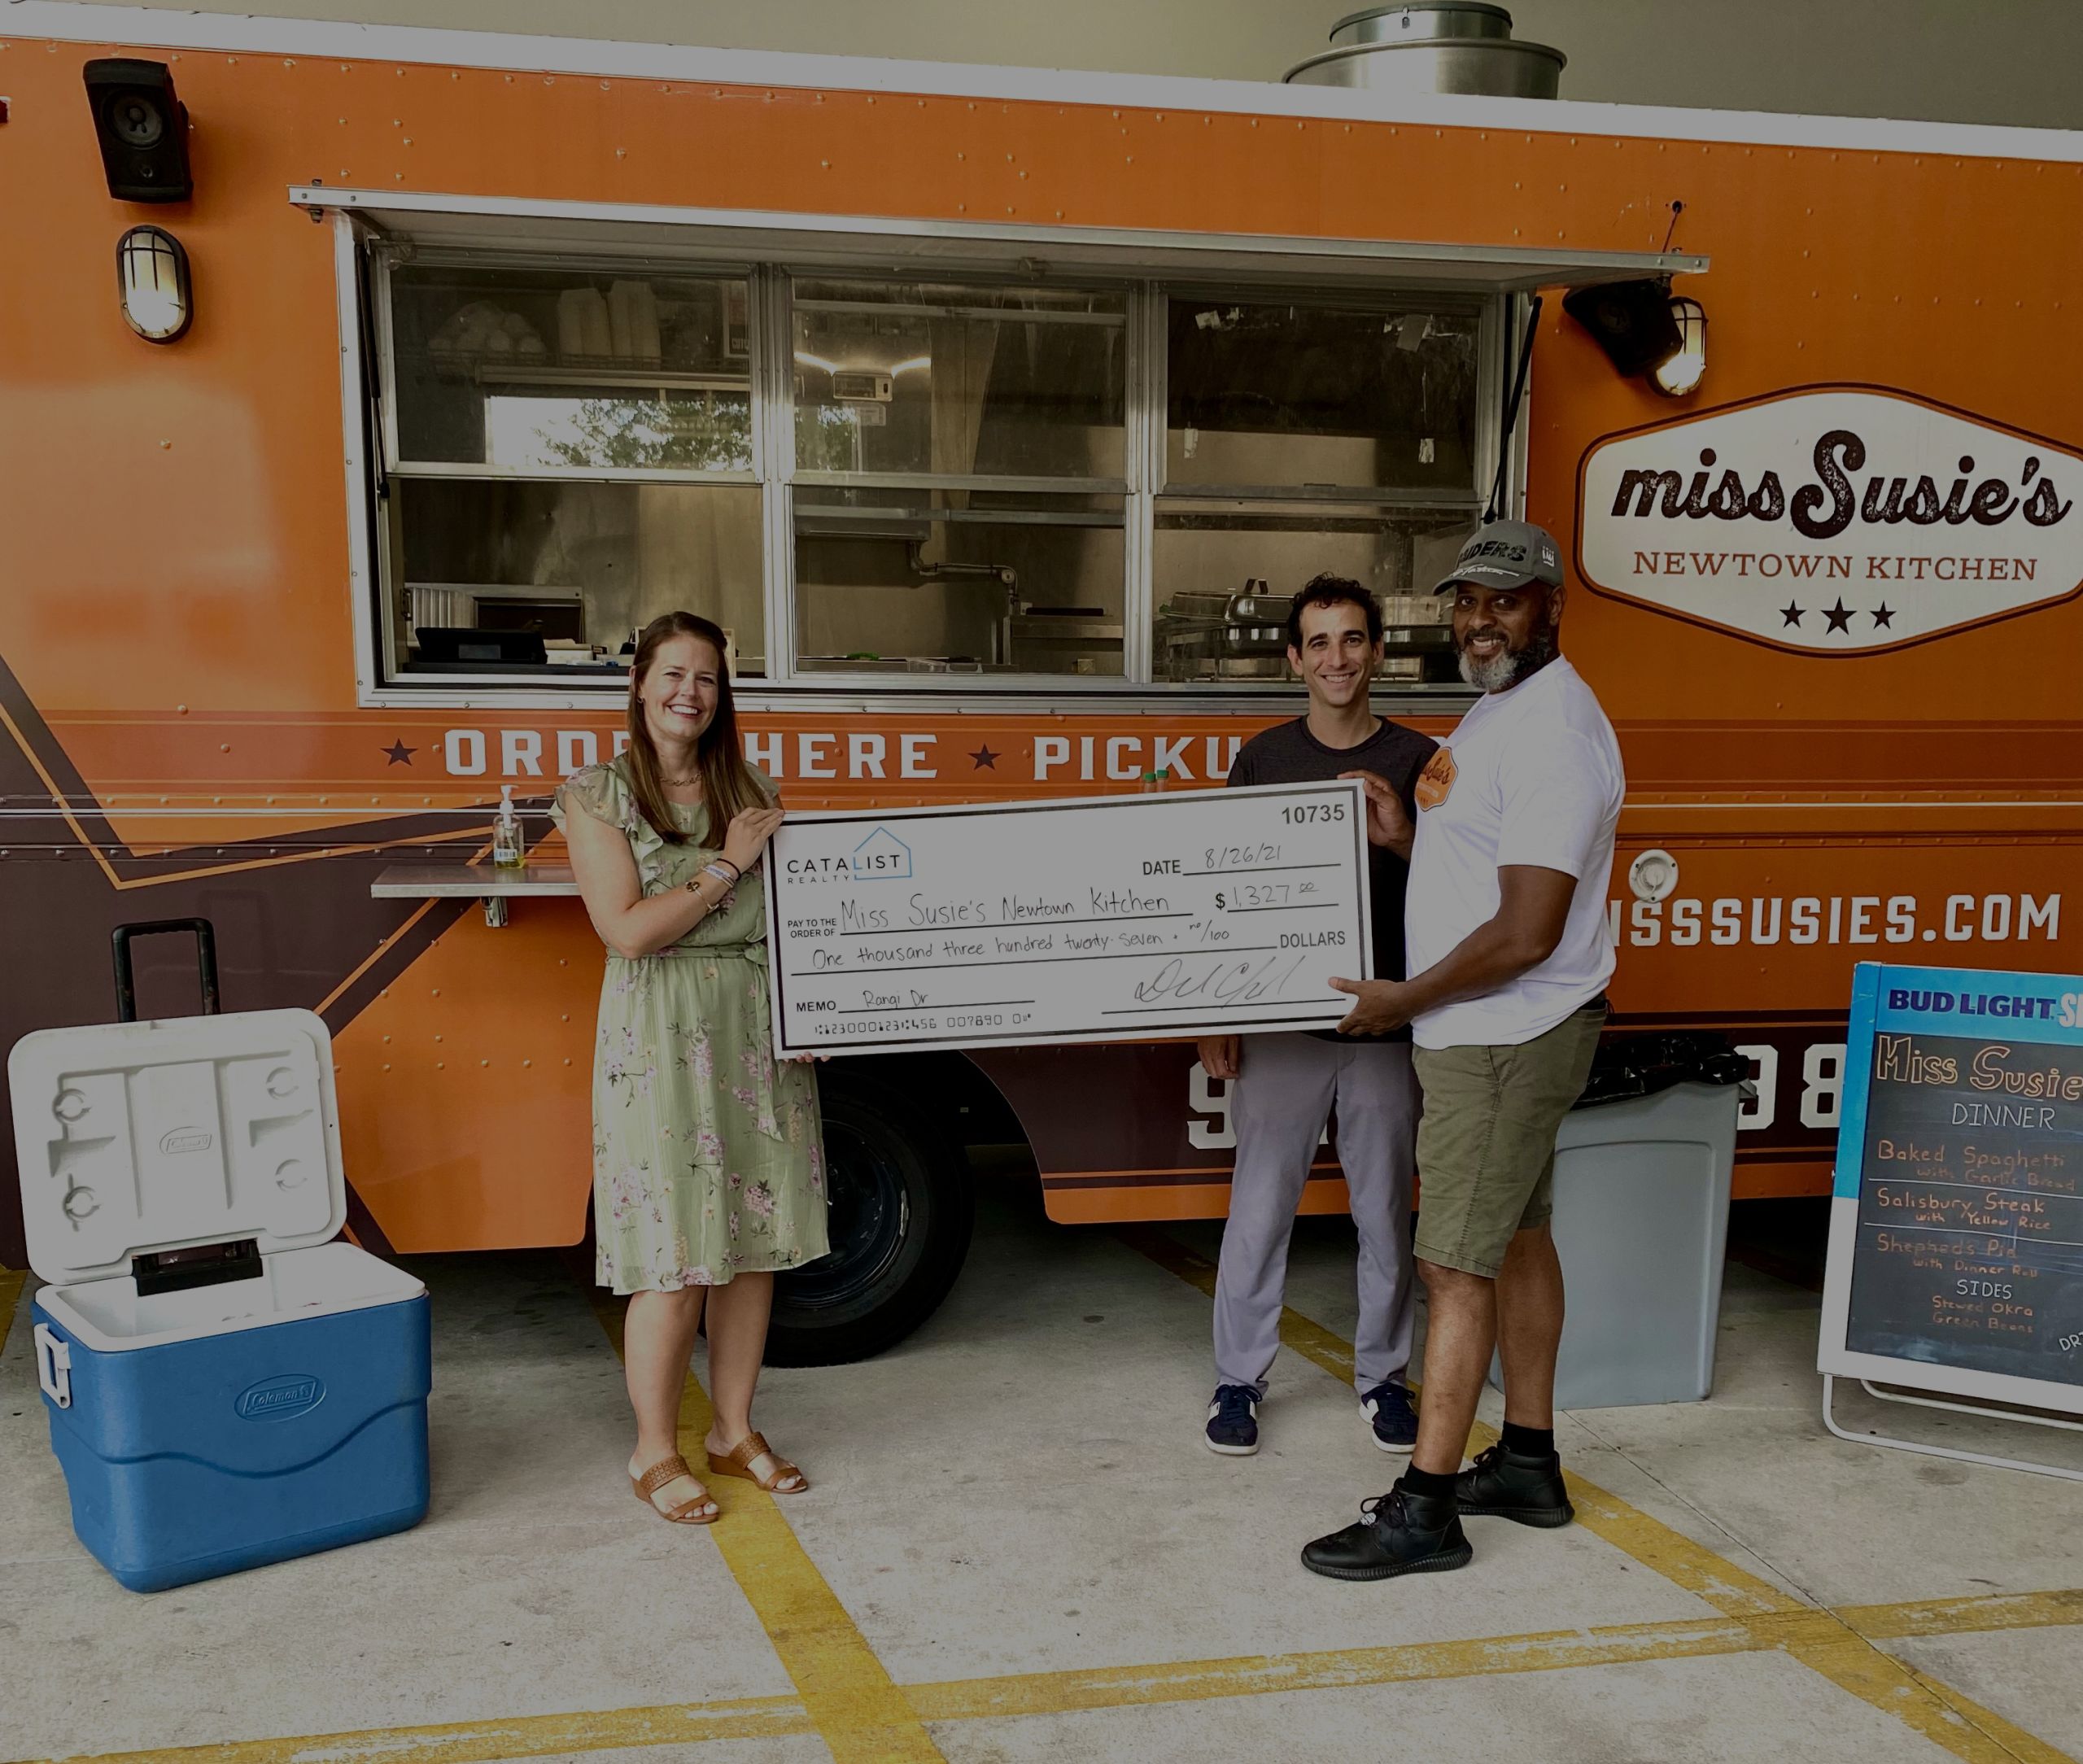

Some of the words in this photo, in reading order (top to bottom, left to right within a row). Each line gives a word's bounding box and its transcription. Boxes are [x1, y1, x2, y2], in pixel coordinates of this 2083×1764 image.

[1611, 448, 1785, 520] miss
[1789, 430, 2073, 539] Susie's
[1634, 551, 1853, 579] NEWTOWN
[1866, 557, 2038, 581] KITCHEN
[745, 732, 938, 779] HERE
[1033, 736, 1242, 781] PICKU
[1282, 804, 1345, 824] 10735
[787, 854, 900, 874] CATALIST
[1205, 843, 1282, 869] 8/26/21
[1142, 859, 1181, 875] DATE
[788, 875, 849, 884] REALTY
[841, 898, 889, 932] Miss
[908, 893, 987, 927] Susie's
[1002, 894, 1075, 921] Newtown
[1090, 886, 1169, 915] Kitchen
[788, 919, 806, 928] PAY
[806, 919, 818, 928] TO
[820, 918, 837, 927] THE
[1609, 893, 2062, 947] ISSSUSIES.COM
[790, 929, 822, 938] ORDER
[824, 928, 836, 937] OF
[1280, 931, 1346, 949] DOLLARS
[813, 949, 845, 970] One
[856, 943, 933, 963] thousand
[941, 941, 985, 958] three
[995, 934, 1053, 954] hundred
[796, 1000, 837, 1012] MEMO
[910, 989, 929, 1007] Dr
[1889, 989, 1954, 1013] BUD
[1959, 993, 2057, 1019] LIGHT
[1876, 1035, 1959, 1085] Miss
[1952, 1103, 2057, 1131] DINNER
[1878, 1140, 1945, 1163] Baked
[1963, 1146, 2067, 1172] Spaghetti
[1876, 1187, 1973, 1218] Salisbury
[1984, 1192, 2046, 1213] Steak
[1915, 1212, 1945, 1223] with
[1966, 1212, 2010, 1225] Yellow
[2018, 1217, 2053, 1230] Rice
[1913, 1259, 1944, 1270] with
[1954, 1260, 2006, 1274] Dinner
[1956, 1279, 2013, 1300] SIDES
[1991, 1303, 2033, 1317] Okra
[1932, 1312, 1980, 1329] Green
[1988, 1317, 2033, 1334] Beans
